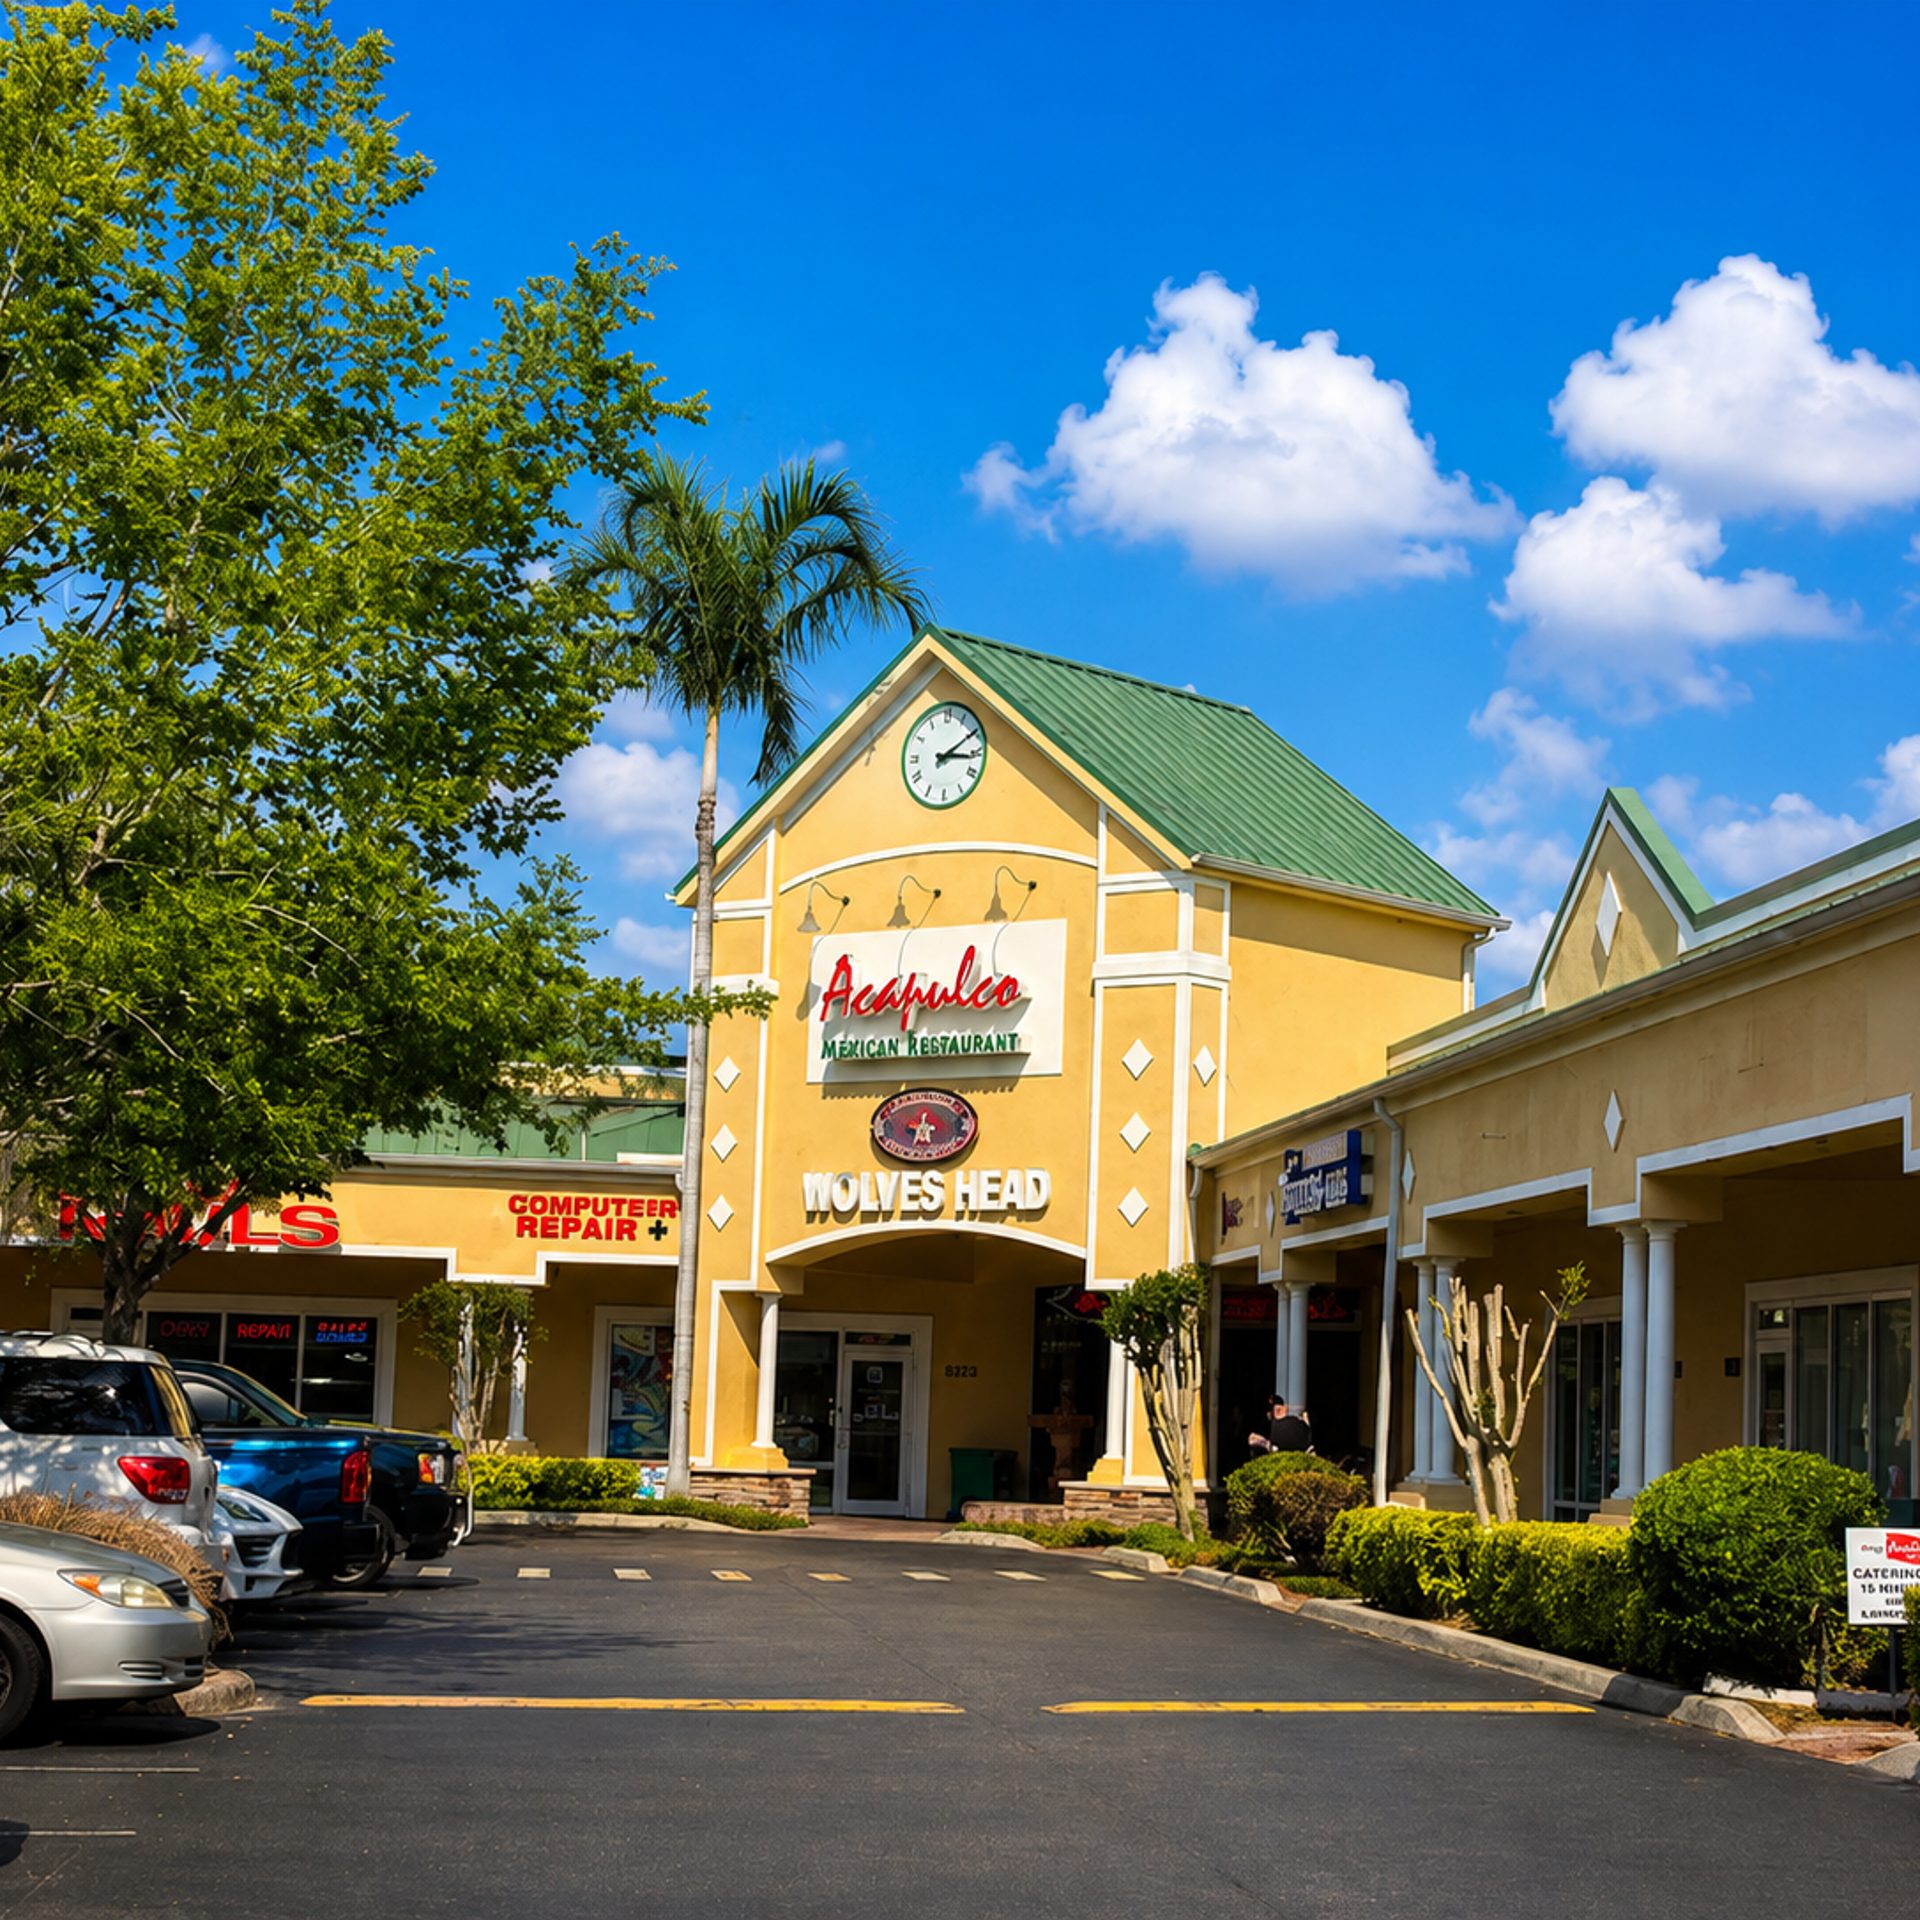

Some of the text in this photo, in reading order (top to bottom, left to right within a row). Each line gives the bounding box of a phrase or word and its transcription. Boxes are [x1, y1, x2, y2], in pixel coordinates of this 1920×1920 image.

[820, 945, 1021, 1031] Acapulco
[821, 1030, 1019, 1060] MEXICAN RESTAURANT
[802, 1168, 1053, 1213] WOLVES HEAD
[516, 1216, 638, 1242] REPAIR
